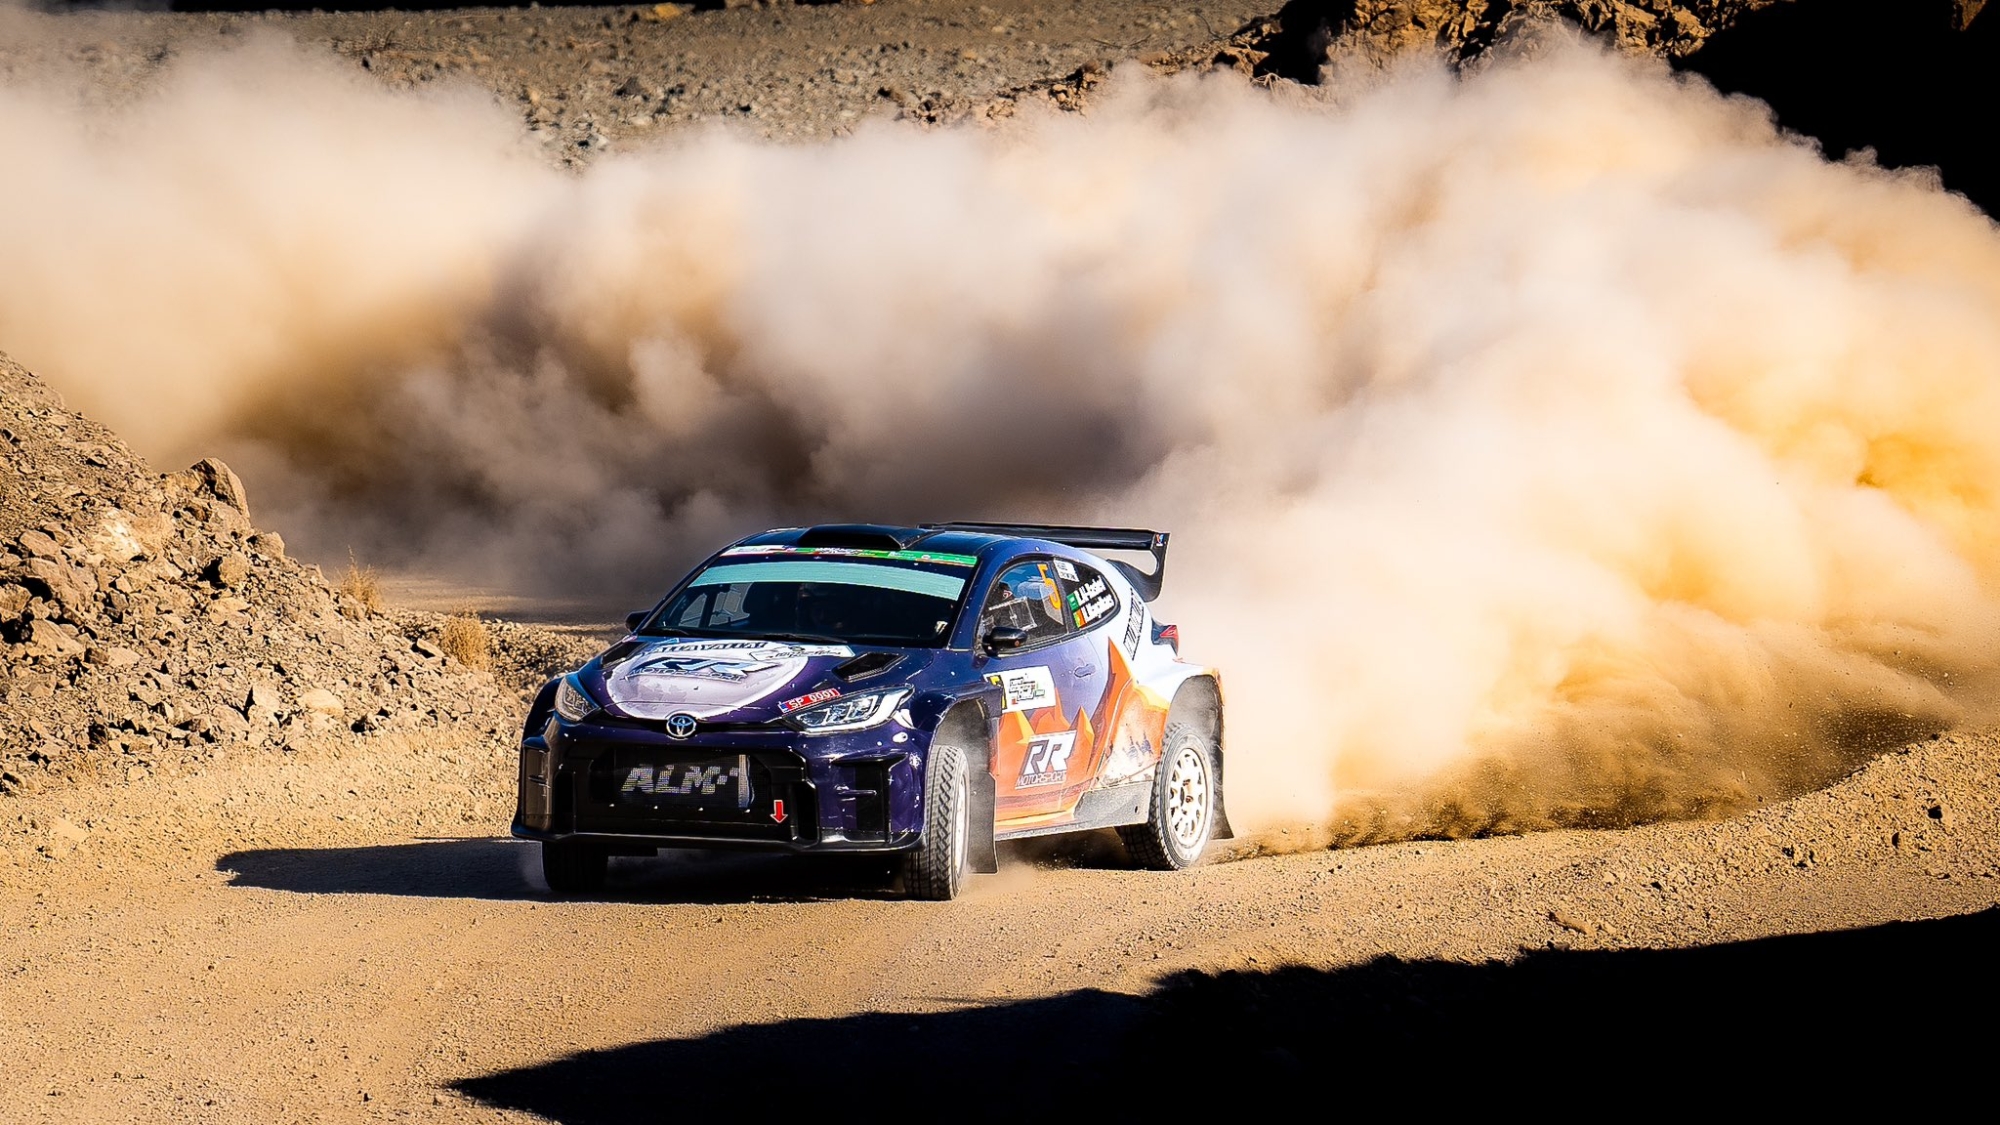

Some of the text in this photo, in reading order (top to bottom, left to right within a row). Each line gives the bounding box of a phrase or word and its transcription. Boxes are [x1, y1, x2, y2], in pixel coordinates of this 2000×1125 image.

[1037, 563, 1063, 610] 5
[788, 688, 836, 709] SP 0001
[1020, 729, 1077, 775] RR
[1016, 770, 1066, 788] MOTORSPORT
